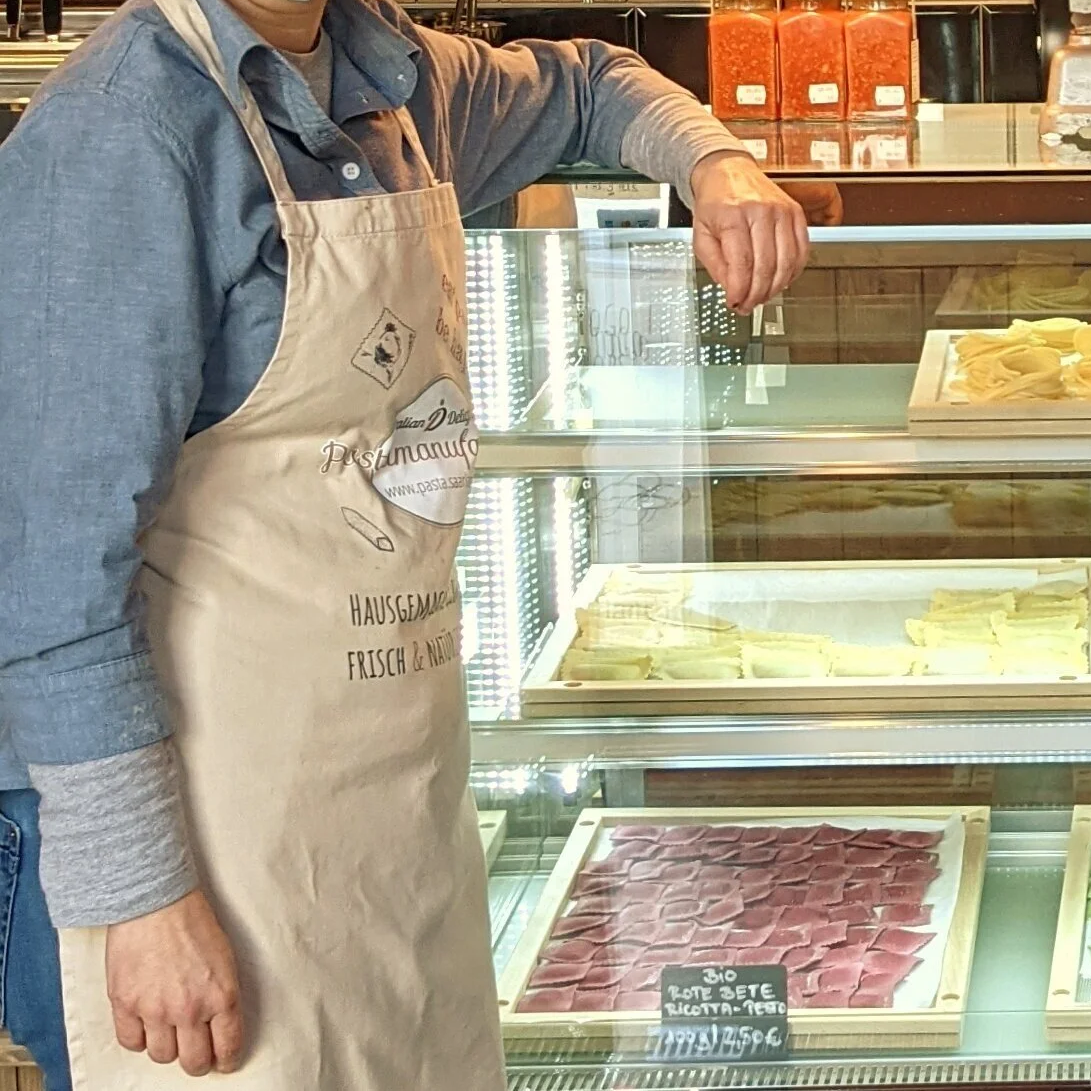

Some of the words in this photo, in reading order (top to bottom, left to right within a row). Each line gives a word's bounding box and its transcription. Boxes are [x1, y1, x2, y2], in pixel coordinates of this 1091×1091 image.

[347, 646, 406, 681] FRISCH
[667, 985, 713, 1001] ROTE
[719, 983, 776, 1000] BETE
